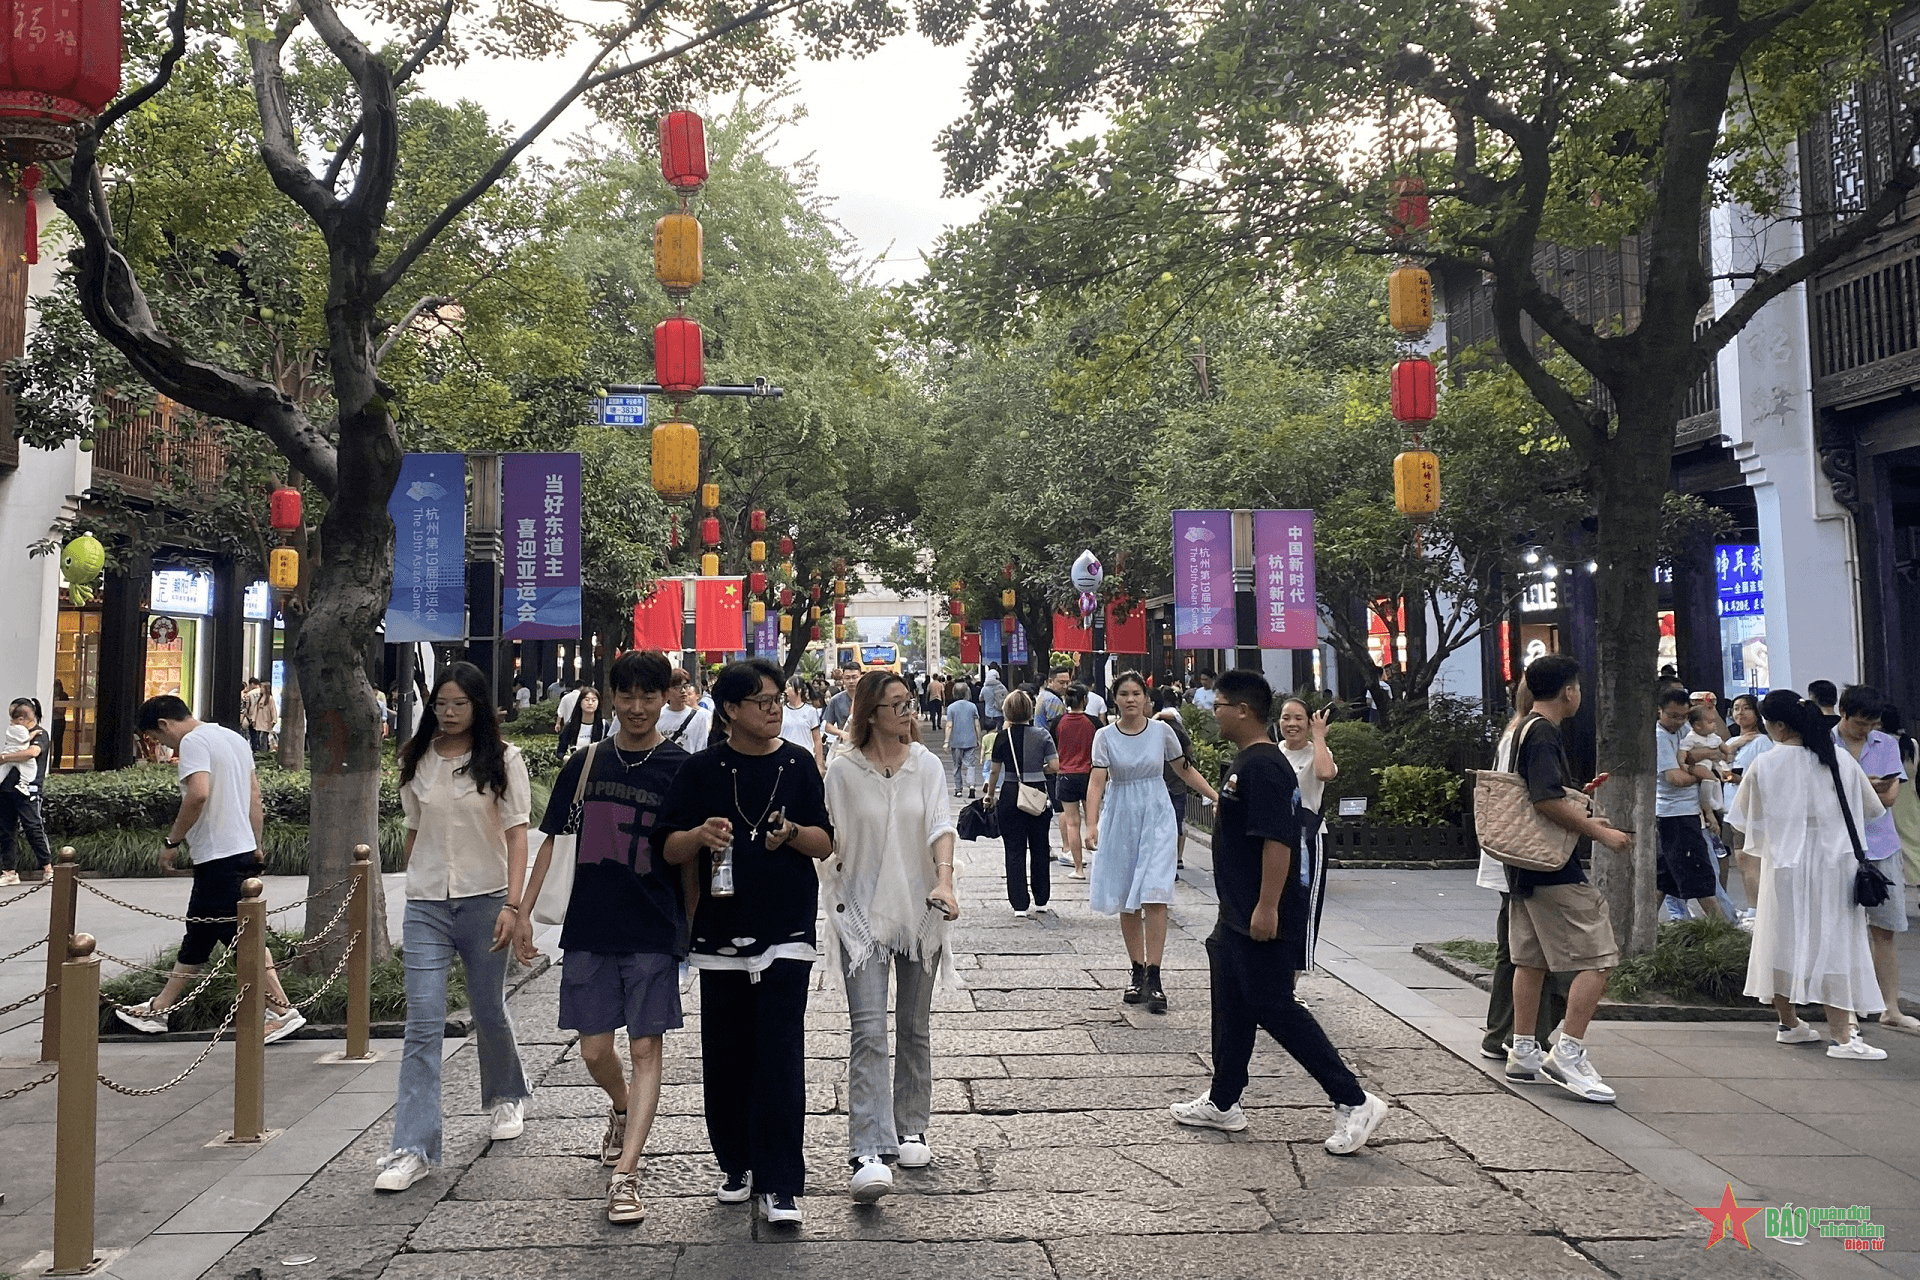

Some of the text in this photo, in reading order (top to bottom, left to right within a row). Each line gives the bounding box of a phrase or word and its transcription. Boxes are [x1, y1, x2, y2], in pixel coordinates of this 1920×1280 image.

[412, 507, 424, 621] The 19th Asian Games
[425, 507, 440, 622] 杭州第19届亚运会
[516, 518, 538, 623] 喜迎亚运会
[543, 473, 565, 578] 当好东道主
[1287, 525, 1306, 603] 中国新时代
[1189, 547, 1200, 635] The 19th Asian Games
[1199, 547, 1212, 636] 杭州第19届亚运会
[1268, 554, 1286, 633] 杭州新亚运
